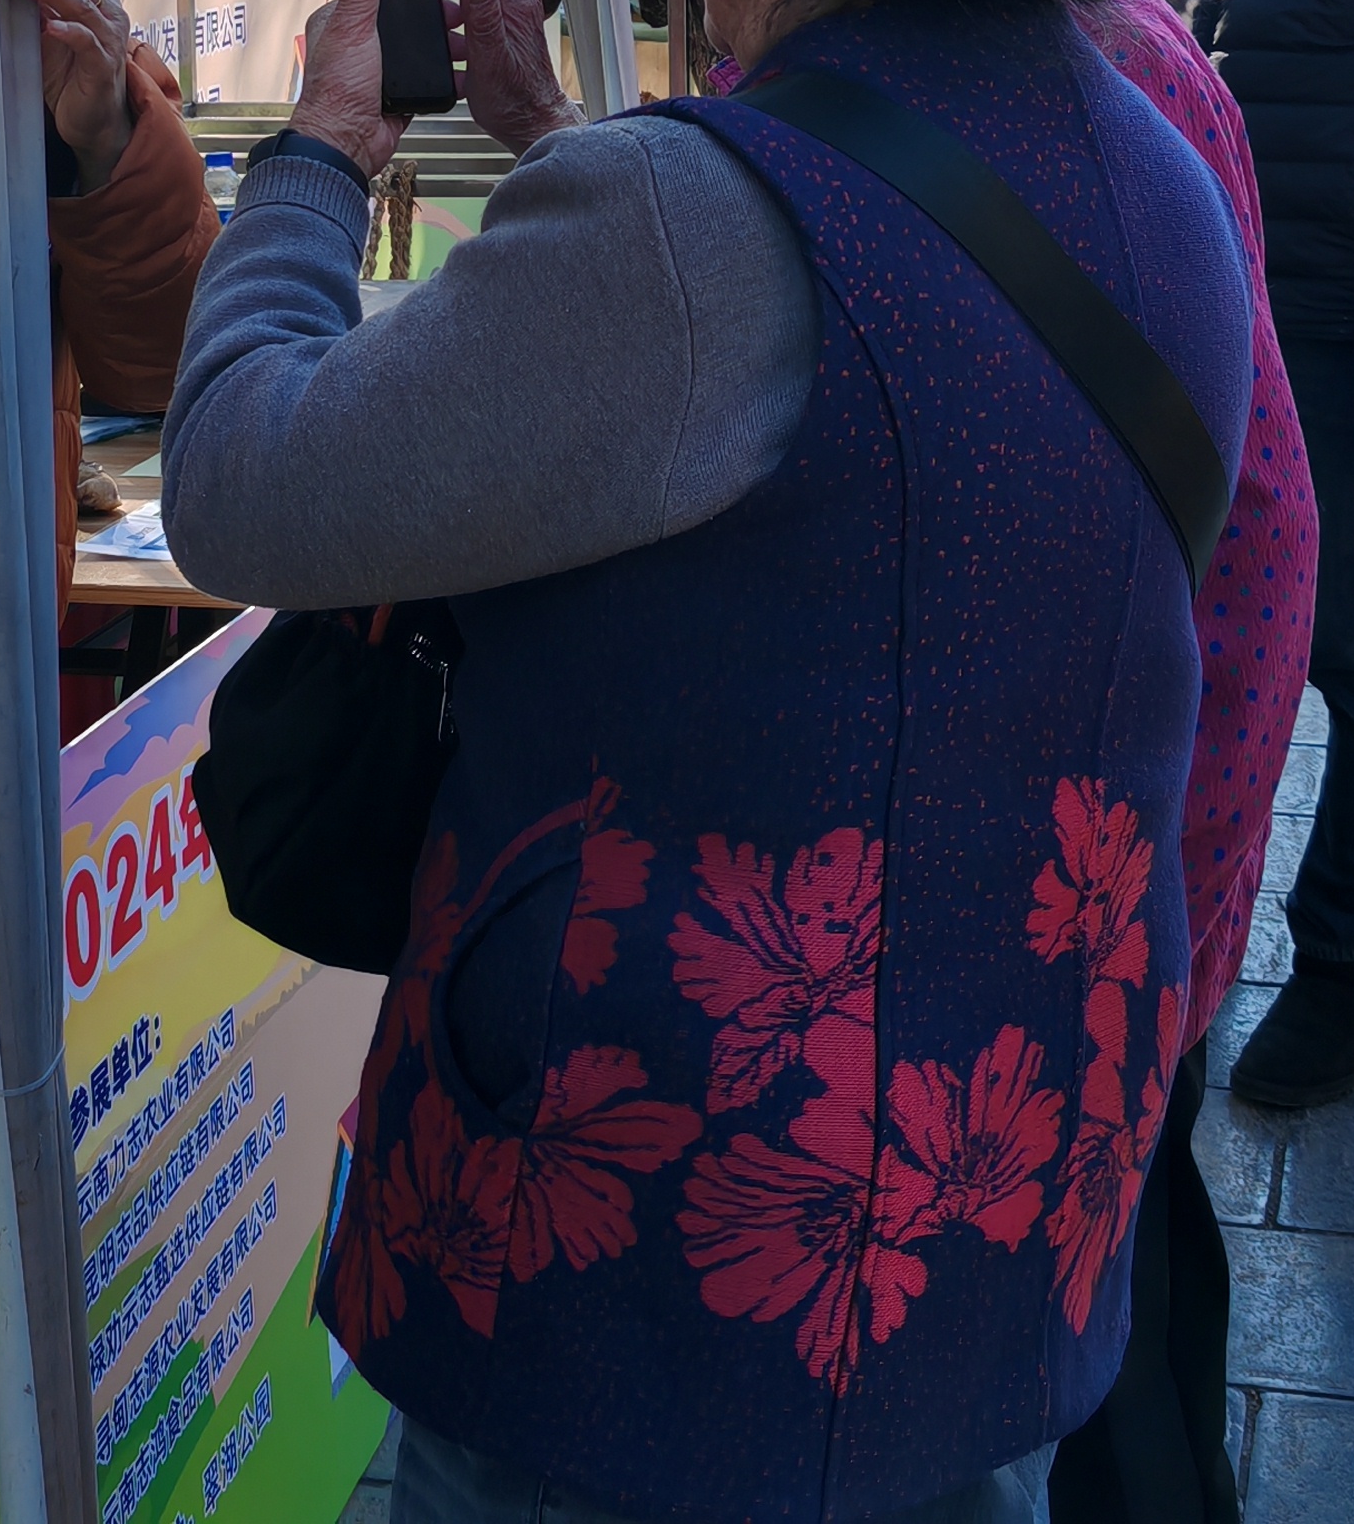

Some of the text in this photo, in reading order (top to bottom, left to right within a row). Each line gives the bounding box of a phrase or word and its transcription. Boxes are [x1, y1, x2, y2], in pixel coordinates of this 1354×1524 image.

[77, 1007, 235, 1224] 云南力志农业有限公司
[85, 1059, 255, 1309] 昆明志品供应链有限公司
[203, 1375, 271, 1514] 翠湖公园
